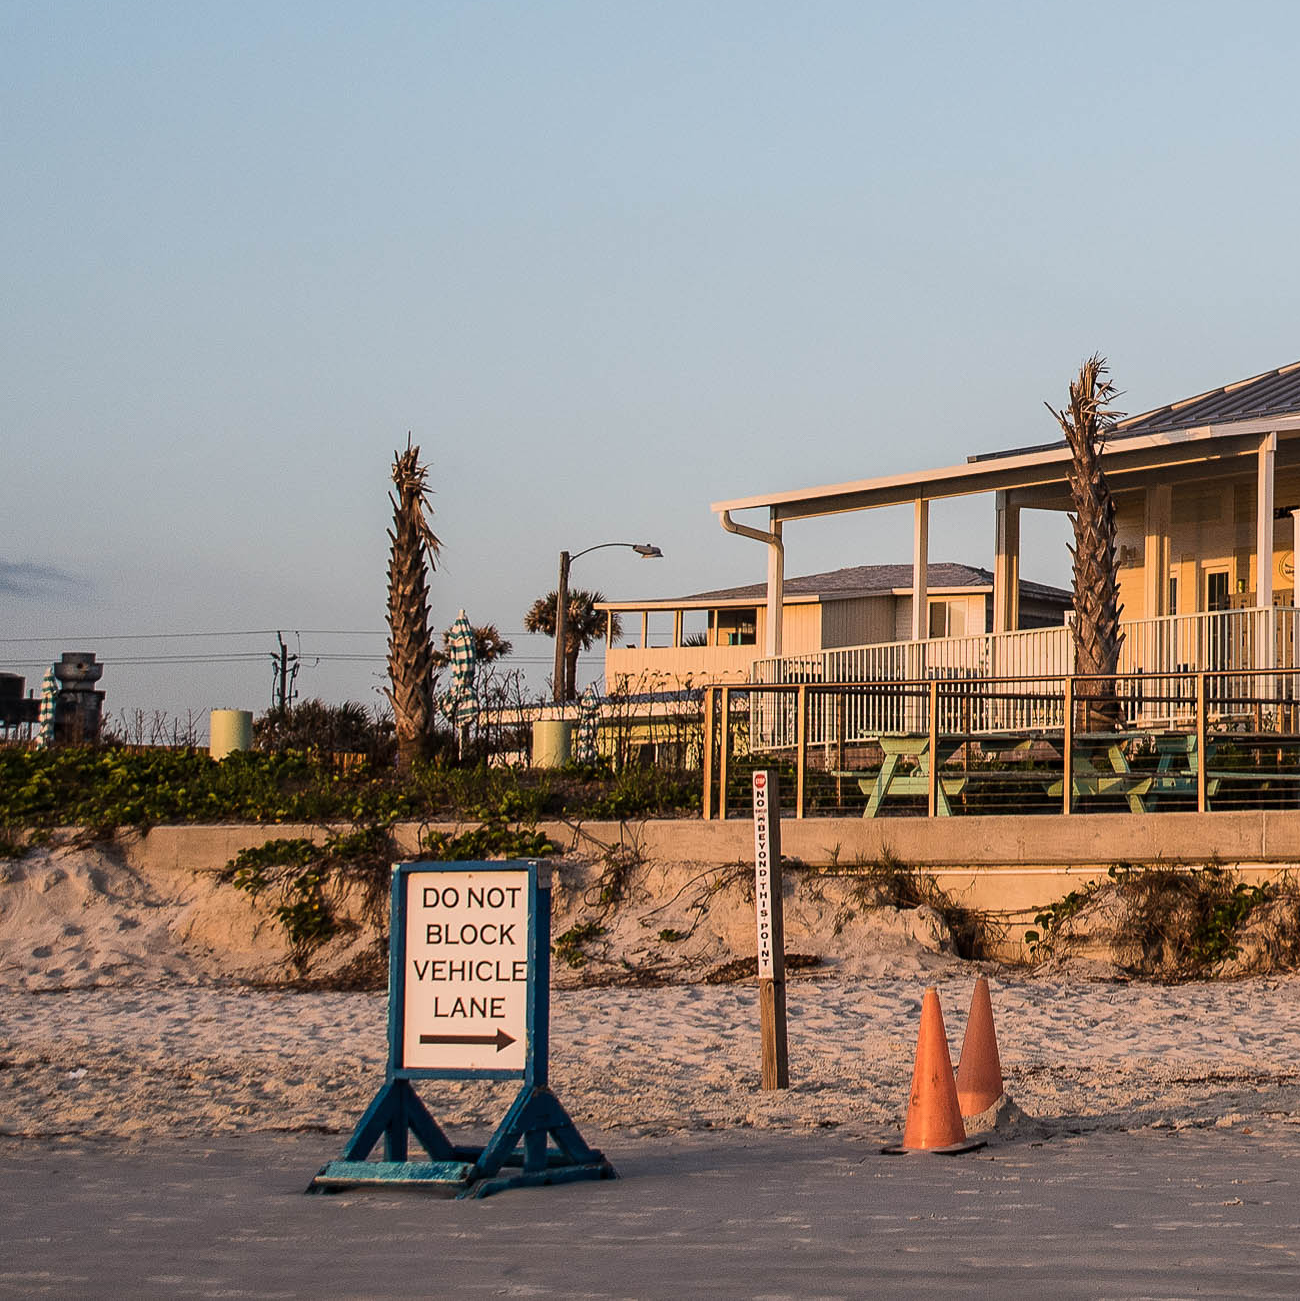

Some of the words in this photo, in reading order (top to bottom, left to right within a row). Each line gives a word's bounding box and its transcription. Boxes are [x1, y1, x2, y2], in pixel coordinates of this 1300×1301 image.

[756, 790, 765, 807] NO
[757, 825, 767, 877] BEYOND
[422, 887, 460, 909] DO
[467, 887, 521, 909] NOT
[759, 883, 768, 917] THIS
[426, 923, 516, 945] BLOCK
[761, 923, 769, 967] POINT
[413, 960, 528, 982] VEHICLE
[434, 996, 506, 1018] LANE
